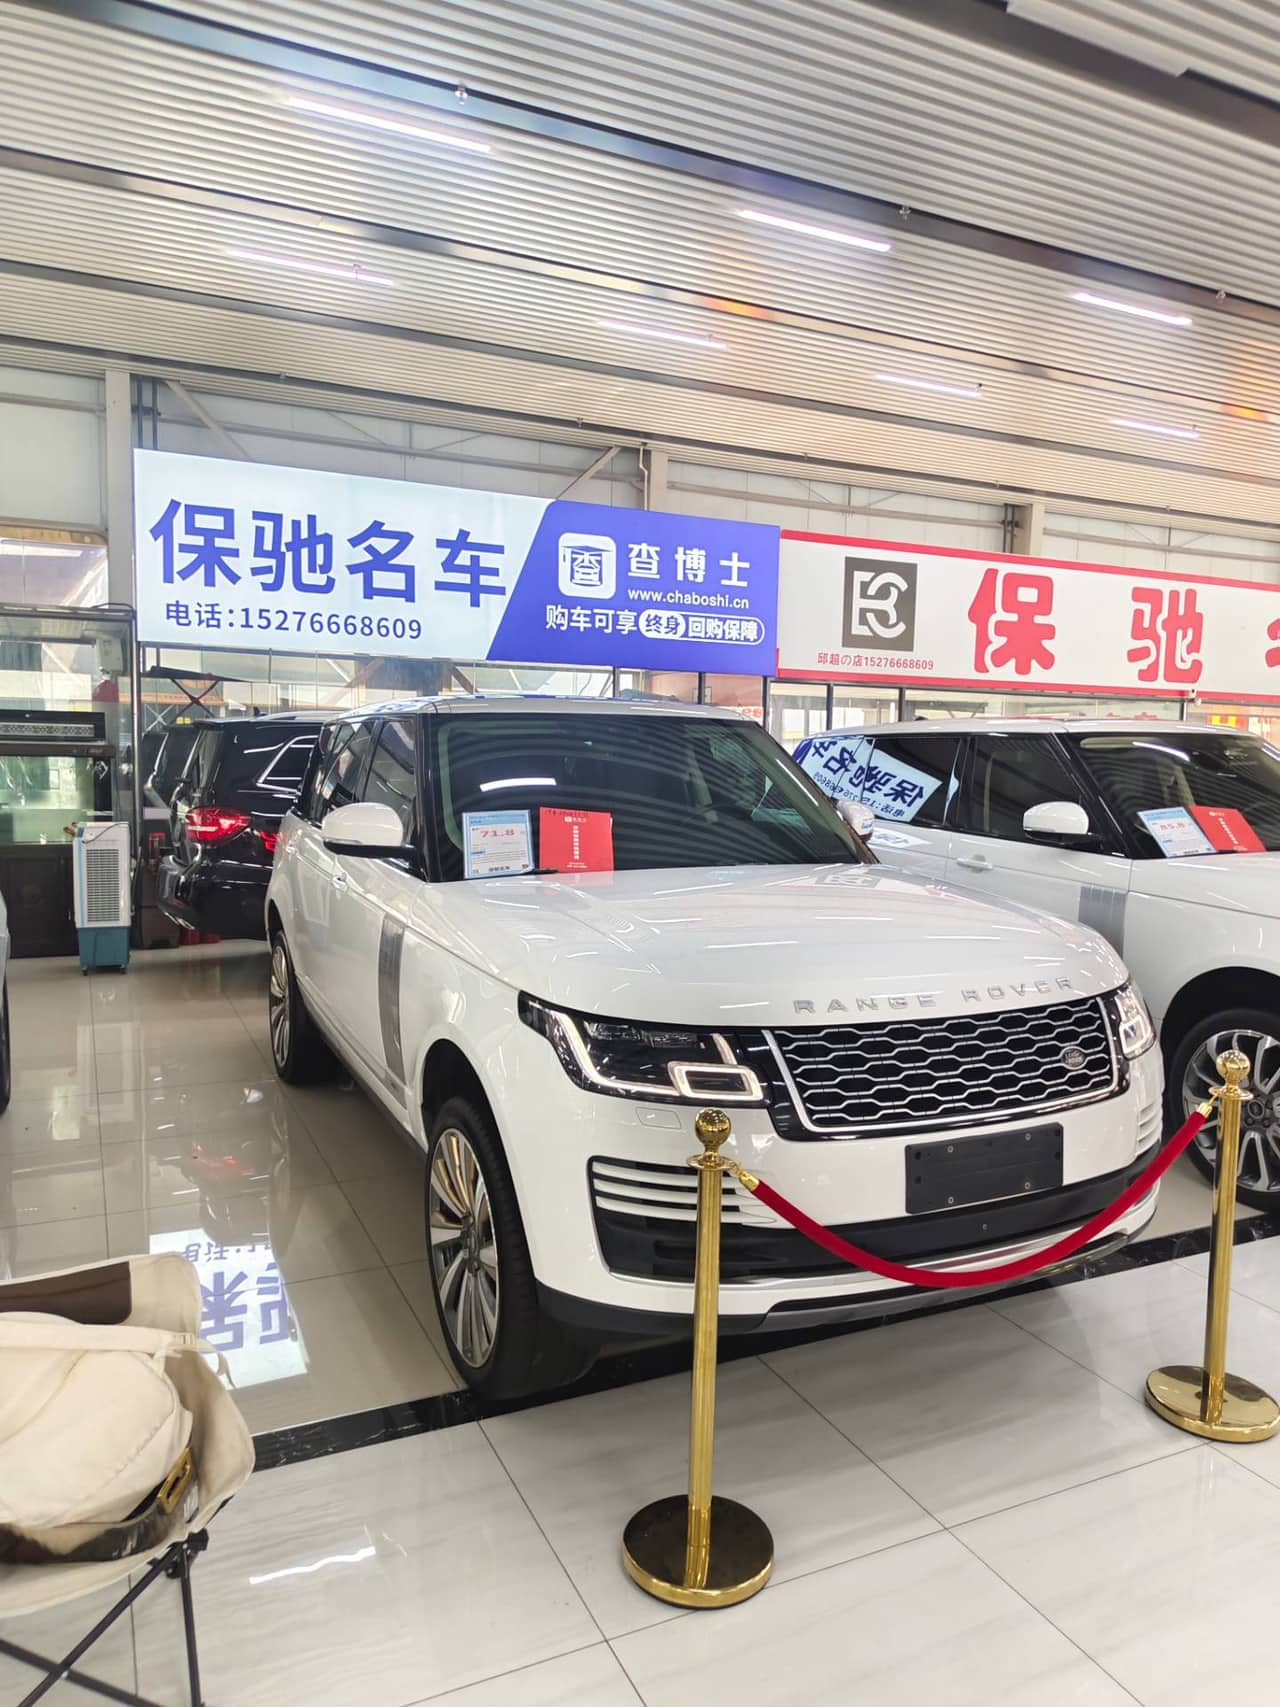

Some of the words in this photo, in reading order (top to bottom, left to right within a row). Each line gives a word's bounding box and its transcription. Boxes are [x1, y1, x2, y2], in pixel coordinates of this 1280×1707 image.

[149, 498, 506, 607] 保驰名车
[627, 542, 750, 587] 查博士
[165, 600, 422, 639] 电话:15276668609
[627, 588, 750, 609] www.chaboshi.cn
[968, 567, 1280, 684] 保驰
[793, 995, 937, 1014] RANGE
[961, 976, 1073, 1002] ROVER
